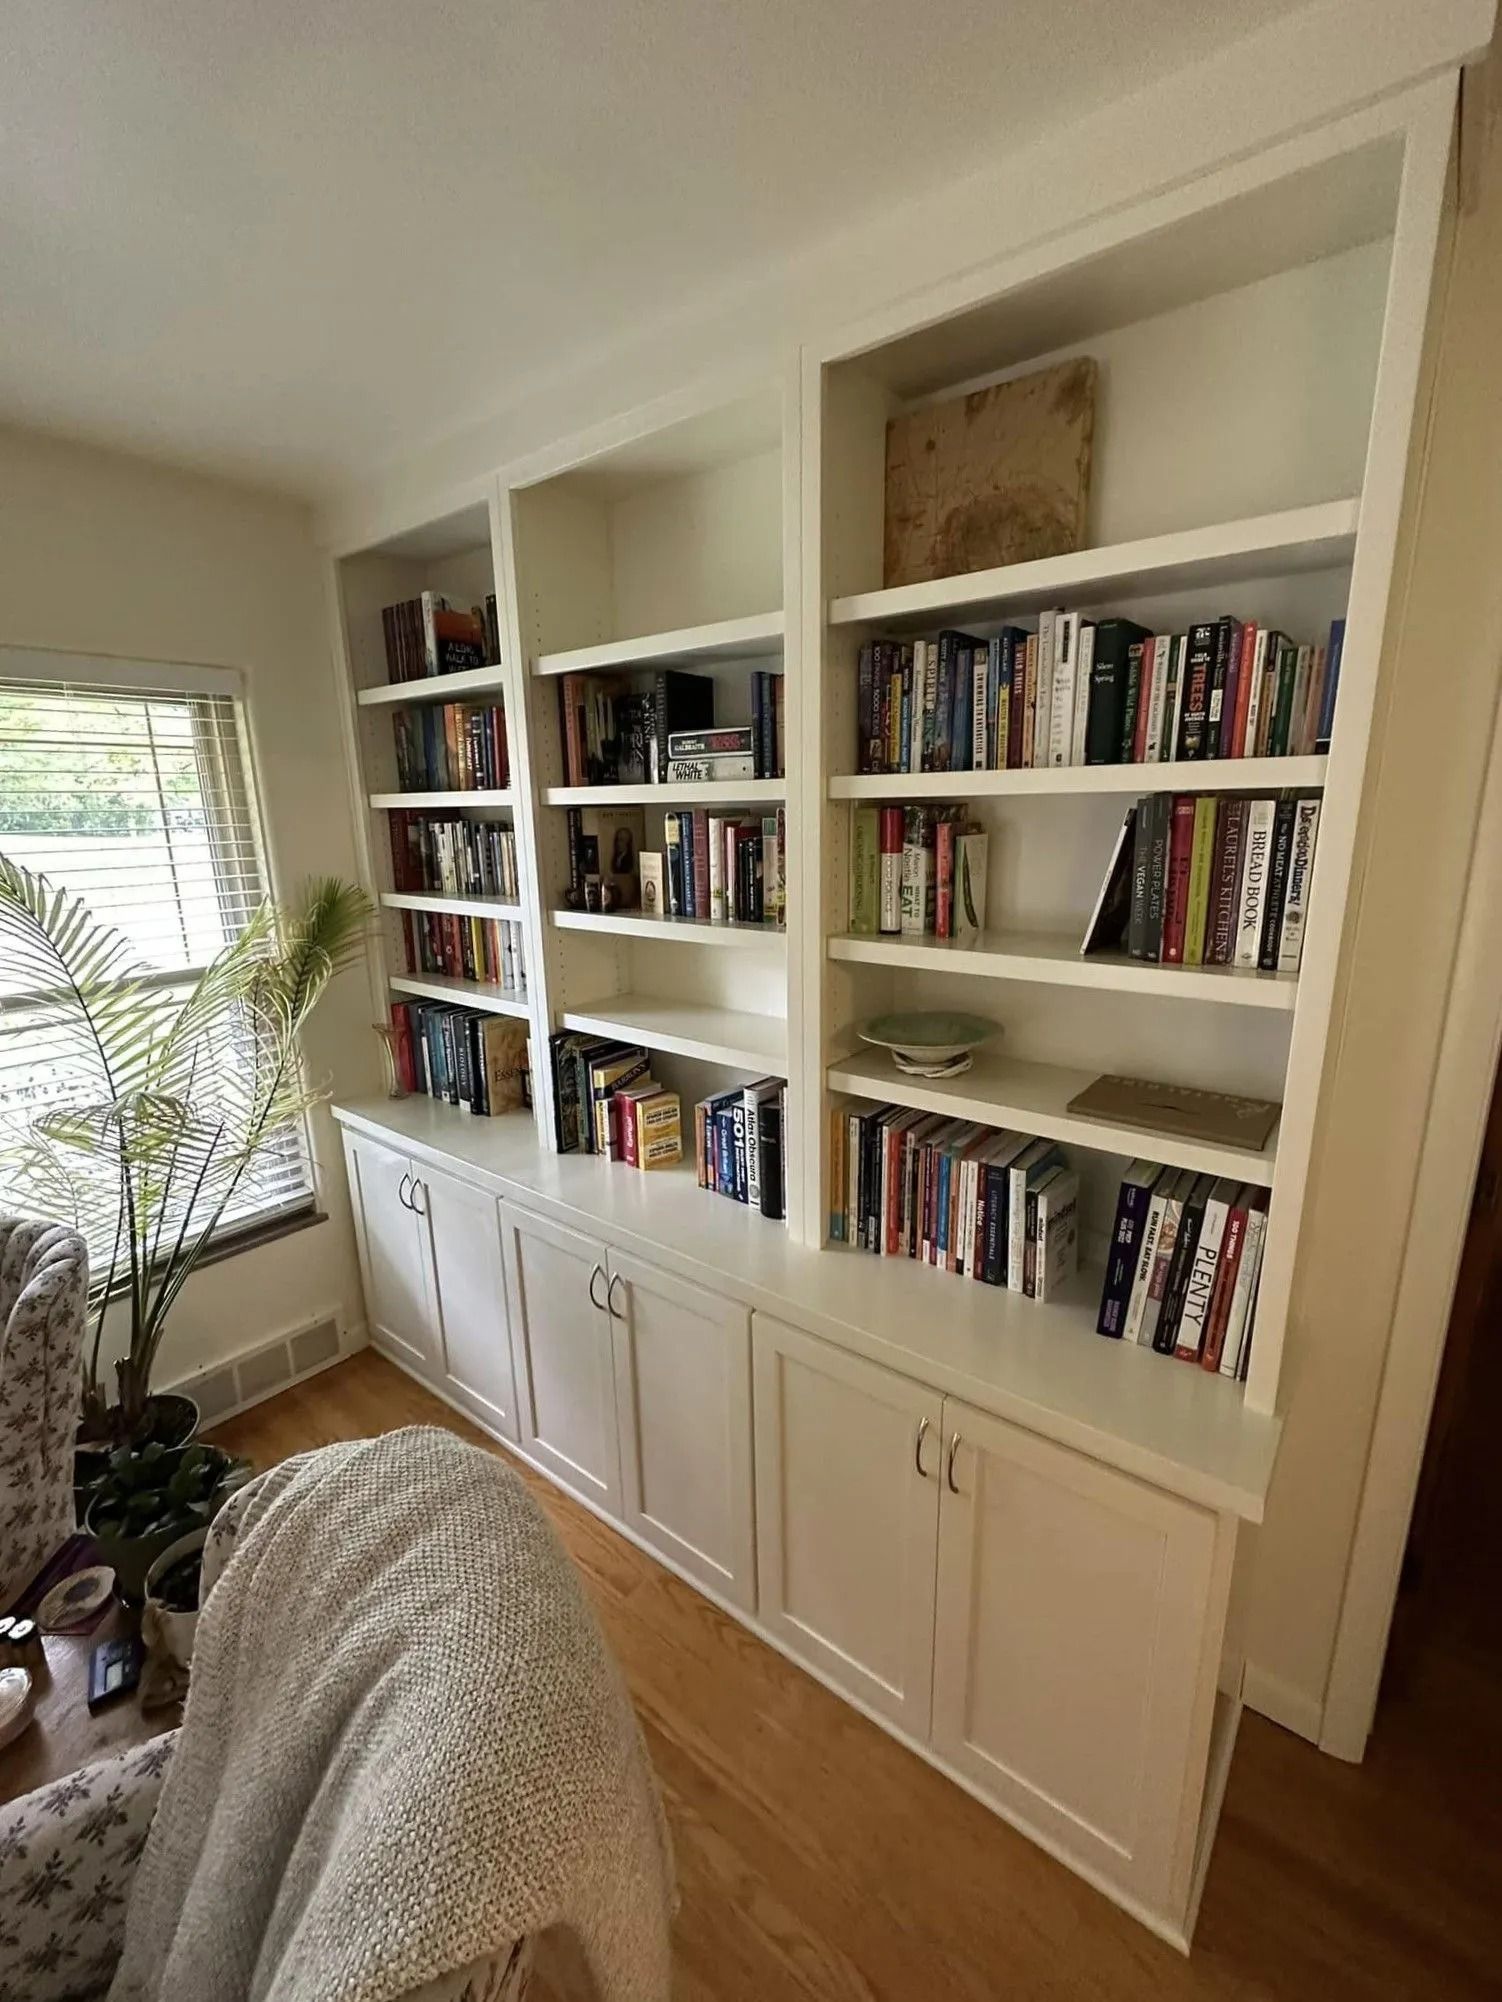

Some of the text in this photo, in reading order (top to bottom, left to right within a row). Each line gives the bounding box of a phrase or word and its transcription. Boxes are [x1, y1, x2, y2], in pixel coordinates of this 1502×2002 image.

[926, 660, 937, 703] SPIRIT
[976, 673, 984, 706] SWIMMING
[1014, 652, 1024, 694] WILD TREES
[1189, 663, 1207, 711] TREES
[976, 717, 984, 754] ANTARCTICA
[673, 762, 699, 771] LETHAL
[675, 769, 703, 781] WHITE
[1277, 835, 1287, 850] NO
[912, 853, 921, 878] Marion
[1149, 839, 1163, 920] POWER PLATES
[1216, 816, 1240, 952] LAUREL'S KITCHEN
[1243, 830, 1267, 931] BREAD BOOK
[1274, 851, 1285, 876] MEAT
[1288, 859, 1308, 907] Dinners!
[902, 885, 913, 918] EAT
[1134, 846, 1147, 925] THE VEGAN WEEK
[1270, 877, 1282, 918] ATHLETE
[913, 908, 920, 918] TO
[458, 1047, 466, 1086] BIOLOGY
[733, 1107, 745, 1148] 501
[746, 1108, 758, 1182] Atlas Obscura
[976, 1200, 985, 1226] Notice
[988, 1190, 998, 1260] LITERACY ESSENTIALS
[1138, 1211, 1159, 1282] RUN FAST. EAT SLOW.
[1226, 1234, 1238, 1259] THINGS
[1184, 1246, 1217, 1326] PLENTY
